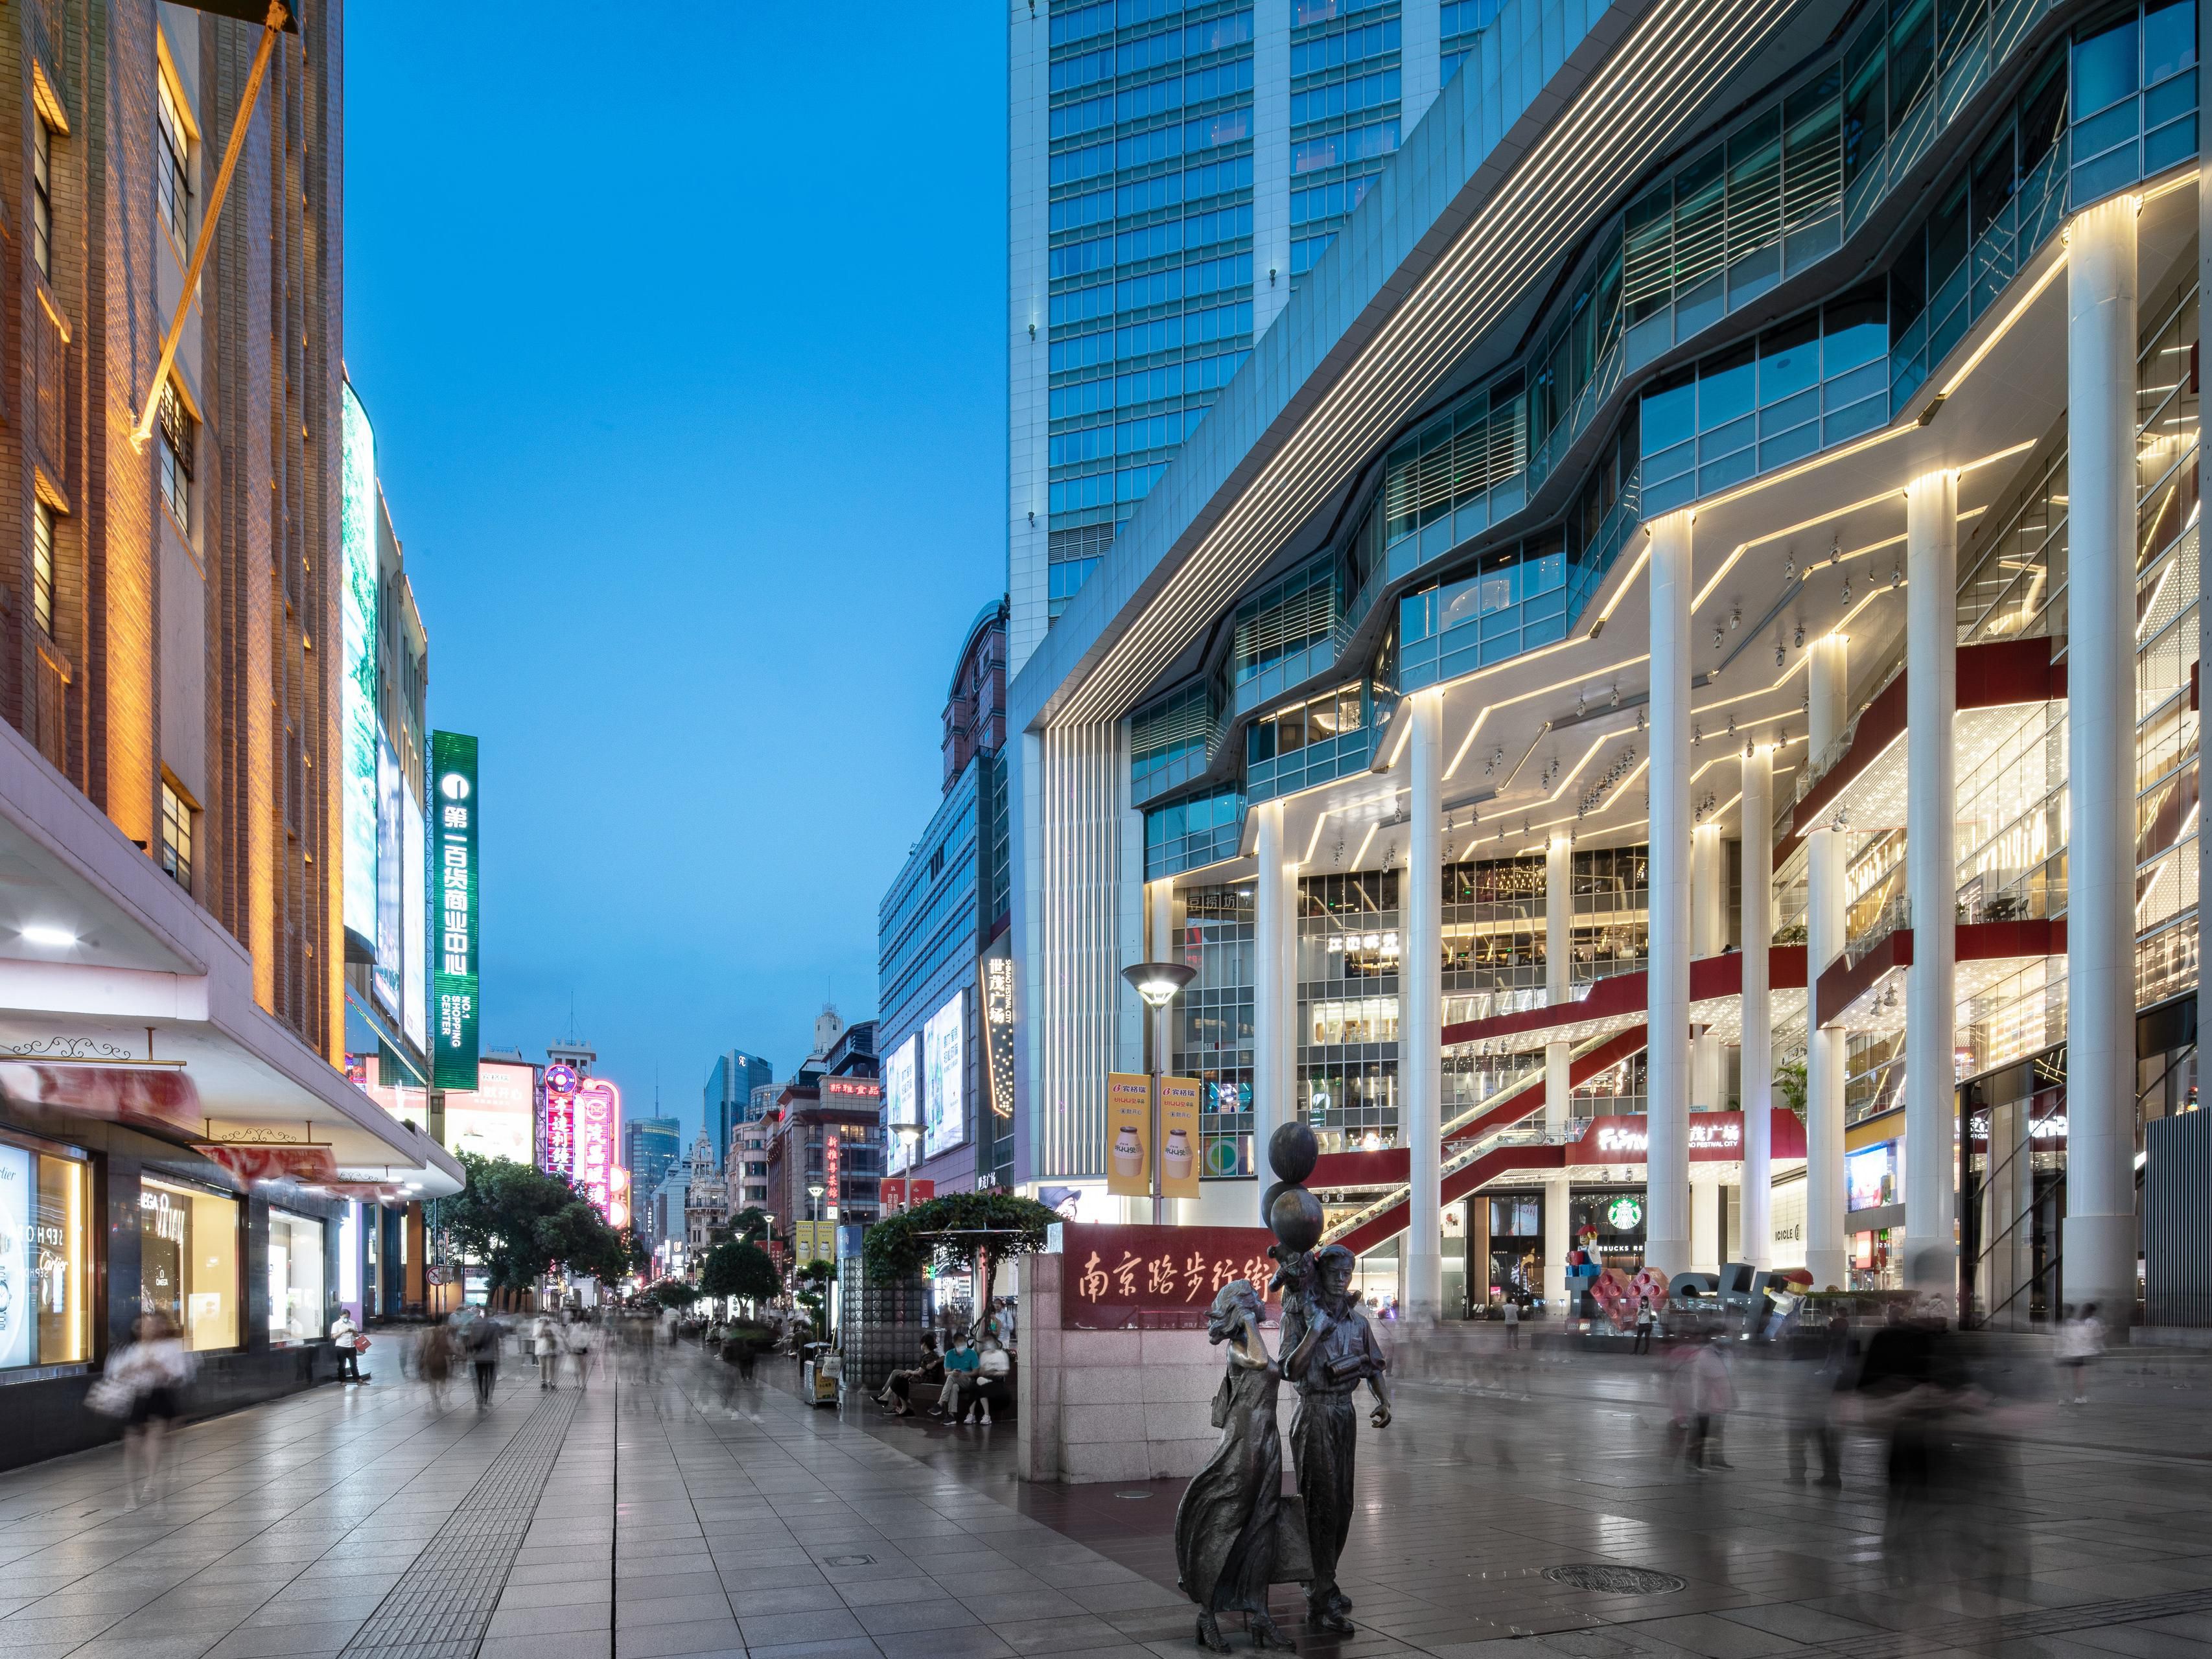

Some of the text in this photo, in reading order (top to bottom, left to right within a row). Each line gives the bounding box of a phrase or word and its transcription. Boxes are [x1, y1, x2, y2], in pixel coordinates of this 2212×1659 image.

[444, 806, 467, 976] 第一百货商业中心
[1187, 894, 1236, 911] 豆捞坊
[989, 958, 1005, 1024] 世茂广场
[441, 994, 451, 1035] CENTER
[461, 995, 471, 1019] NO.1
[452, 995, 461, 1047] SHOPPING
[829, 1084, 879, 1095] 新雅食品
[1123, 1085, 1147, 1093] 宾格瑞
[1690, 1125, 1739, 1141] 茂广场
[978, 1171, 996, 1190] 世茂广场
[1775, 1229, 1793, 1241] ICICLE
[40, 1250, 69, 1271] Cartier
[1079, 1251, 1273, 1304] 南京路步行街
